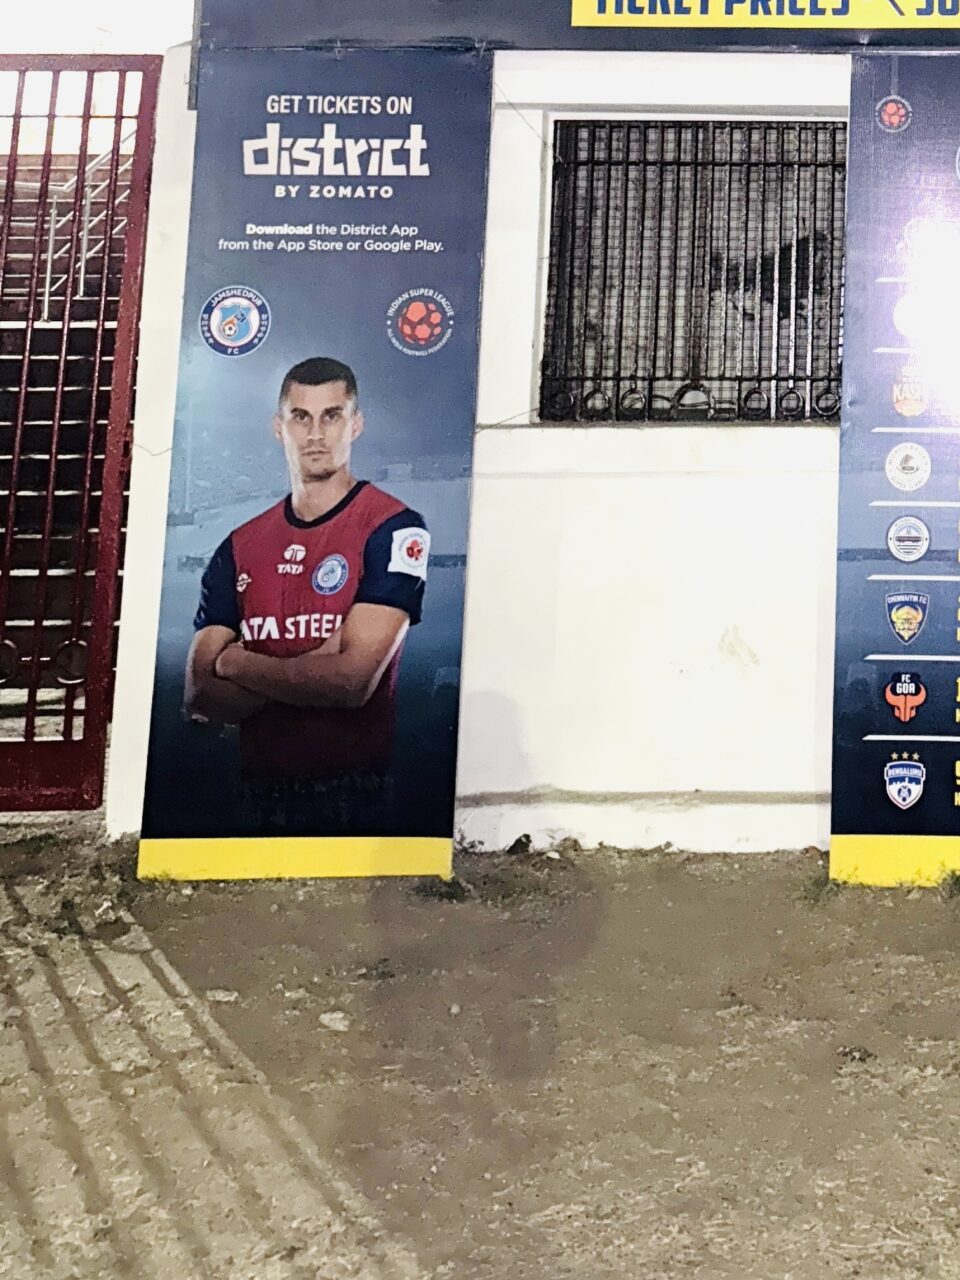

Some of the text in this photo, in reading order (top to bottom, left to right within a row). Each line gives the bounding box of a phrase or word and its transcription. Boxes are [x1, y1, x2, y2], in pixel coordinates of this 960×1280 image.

[266, 95, 412, 115] GET TICKETS ON
[243, 122, 430, 176] district
[275, 185, 393, 199] BY ZOMATO
[246, 224, 418, 238] Download the District App
[218, 239, 444, 253] from the App Store or Google Play.
[210, 289, 263, 307] JAMSHEDPUR
[386, 288, 454, 317] INDIAN SUPER LEAGUE
[276, 563, 303, 575] TATA
[240, 616, 280, 641] ATA
[901, 674, 911, 683] FC
[896, 682, 915, 694] GOA
